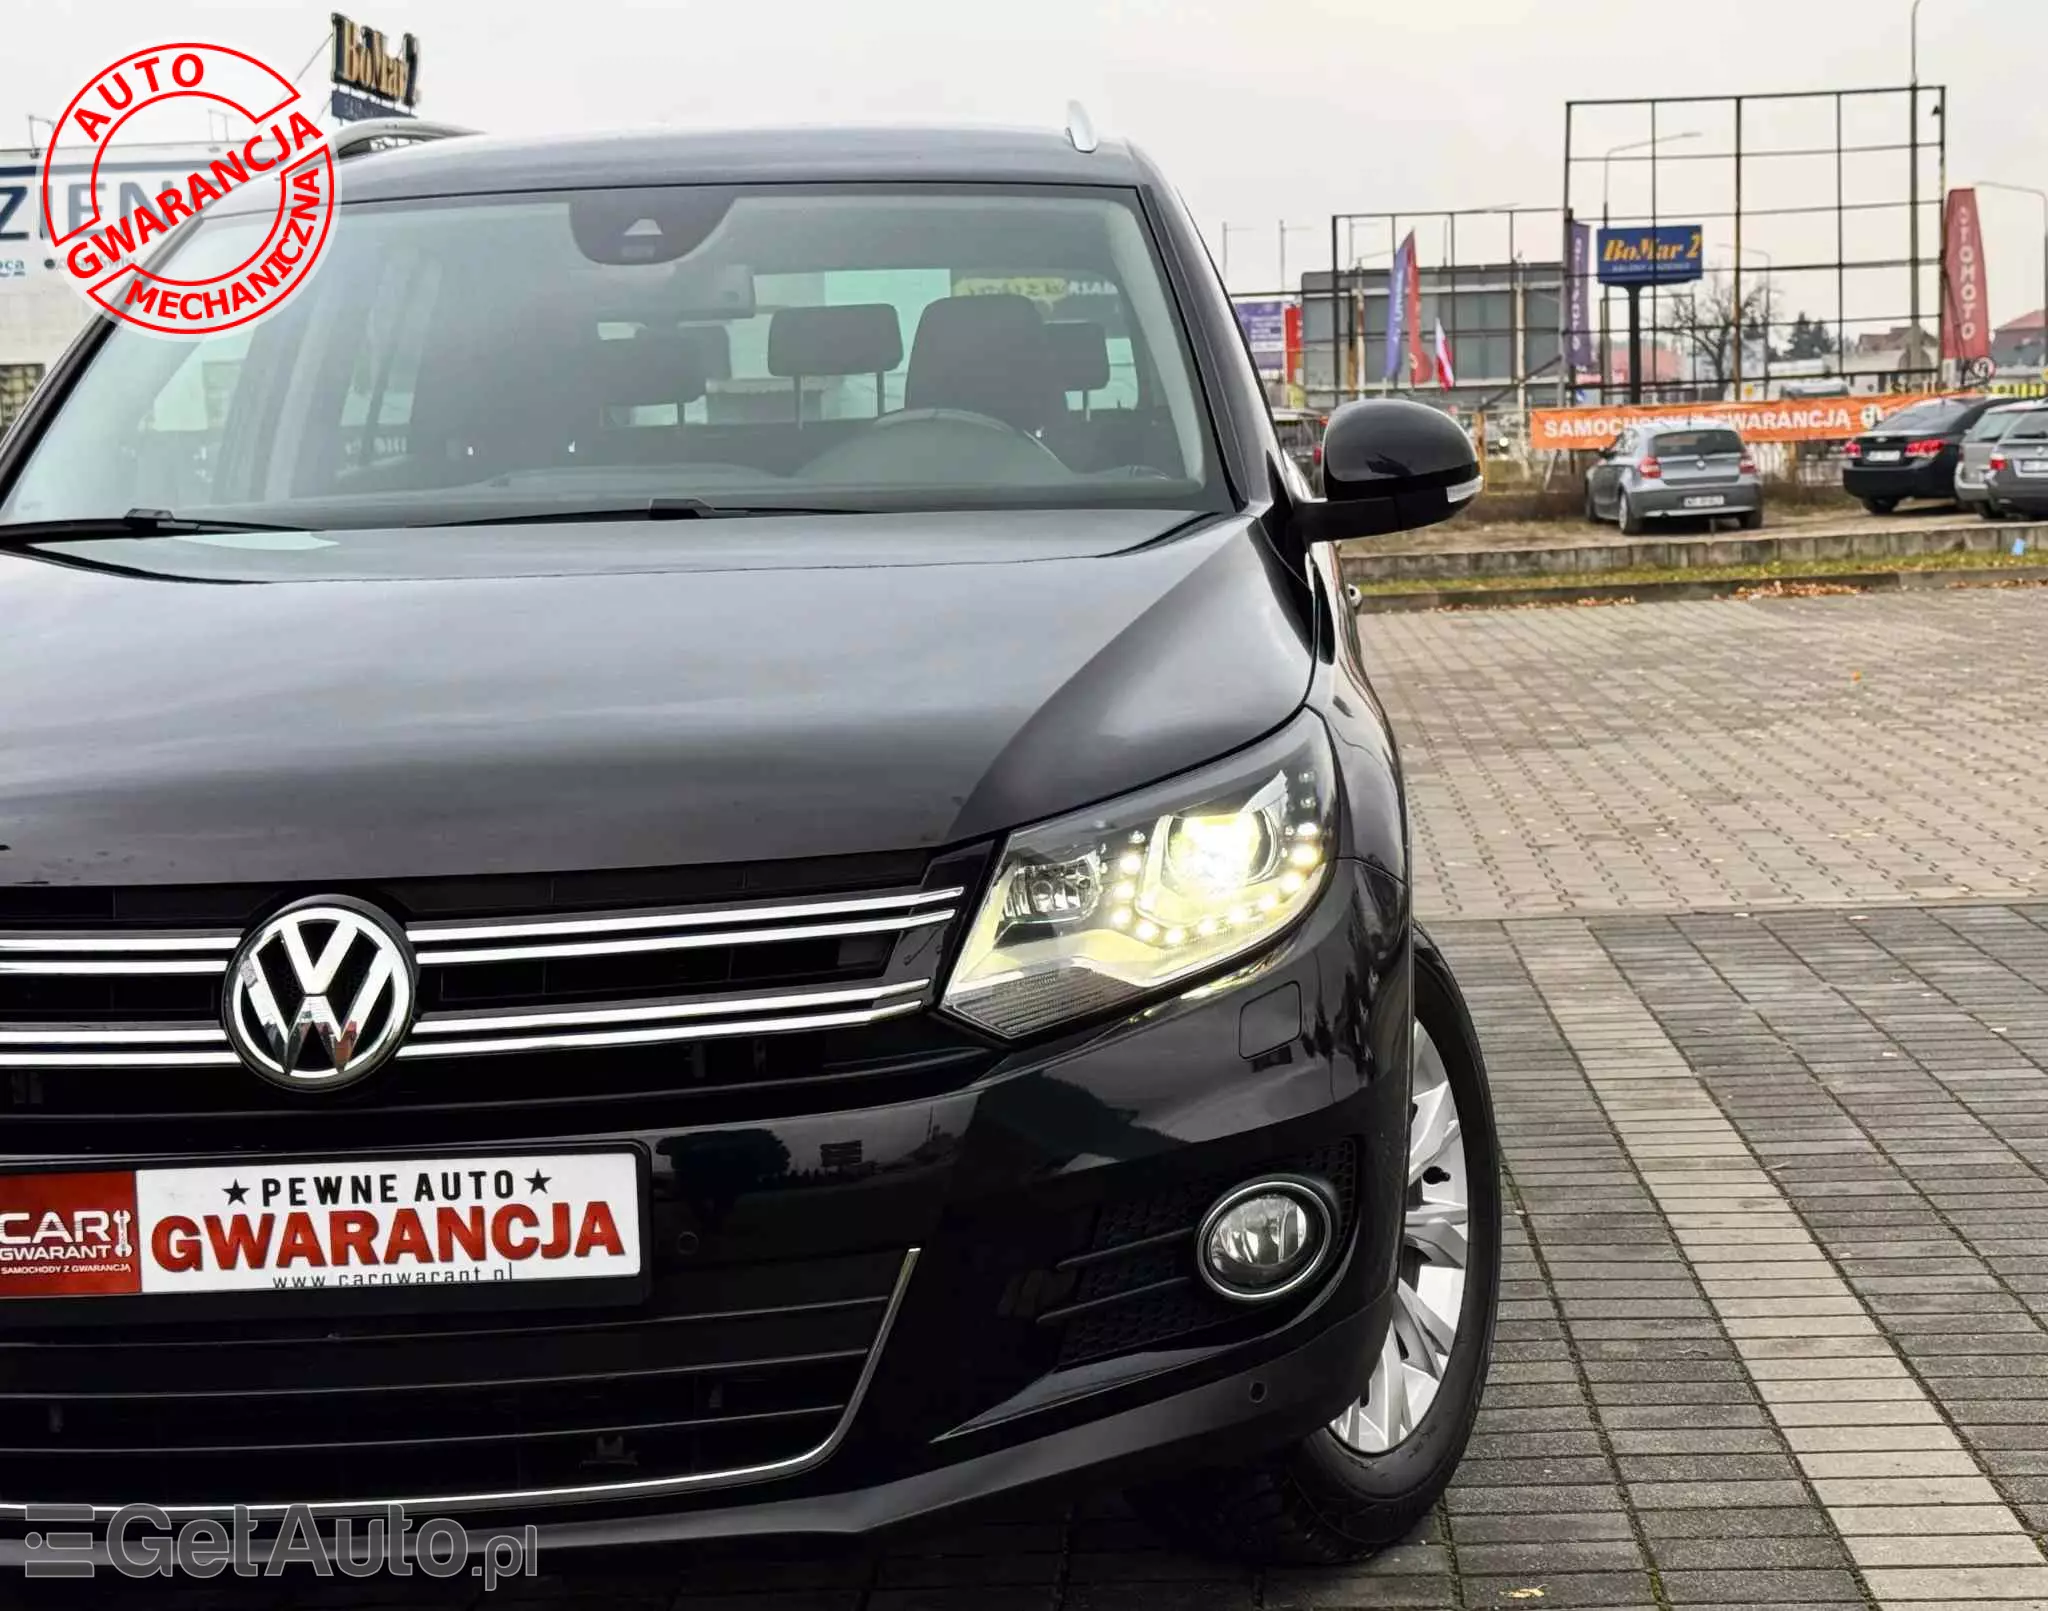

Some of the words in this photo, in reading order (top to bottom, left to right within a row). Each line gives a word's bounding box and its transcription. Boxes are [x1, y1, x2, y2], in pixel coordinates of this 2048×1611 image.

[1686, 233, 1703, 259] 2
[261, 1174, 398, 1207] PEWNE
[415, 1170, 515, 1201] AUTO
[0, 1210, 111, 1244] CAR
[151, 1201, 626, 1273] GWARANCJA
[0, 1245, 112, 1261] GWARANT
[1, 1265, 61, 1275] SAMOCHODY
[63, 1264, 70, 1273] Z
